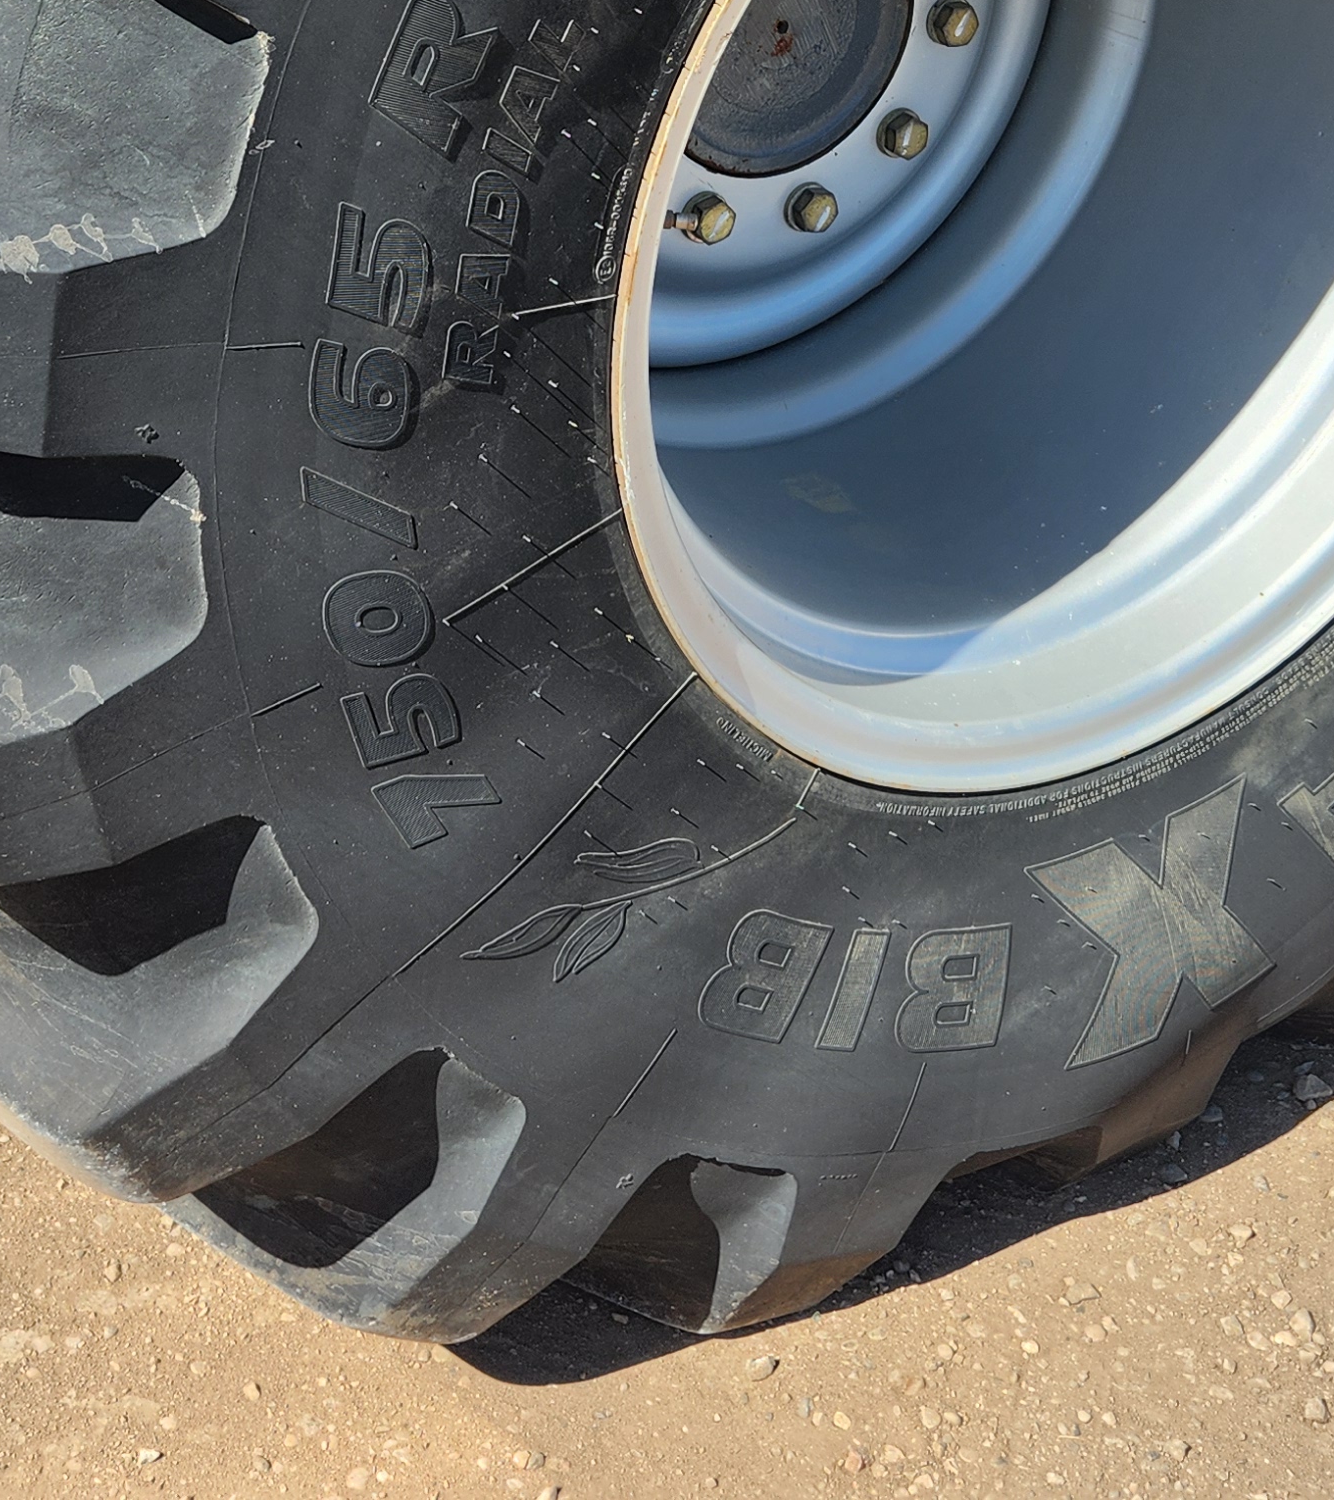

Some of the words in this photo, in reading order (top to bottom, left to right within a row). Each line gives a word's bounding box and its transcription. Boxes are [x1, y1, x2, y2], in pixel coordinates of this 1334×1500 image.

[1225, 686, 1270, 719] CONSULT
[1070, 762, 1143, 793] INSTRUCTIONS
[988, 795, 1047, 812] ADDITIONAL
[1048, 789, 1069, 801] FOR
[947, 805, 986, 815] SAFETY
